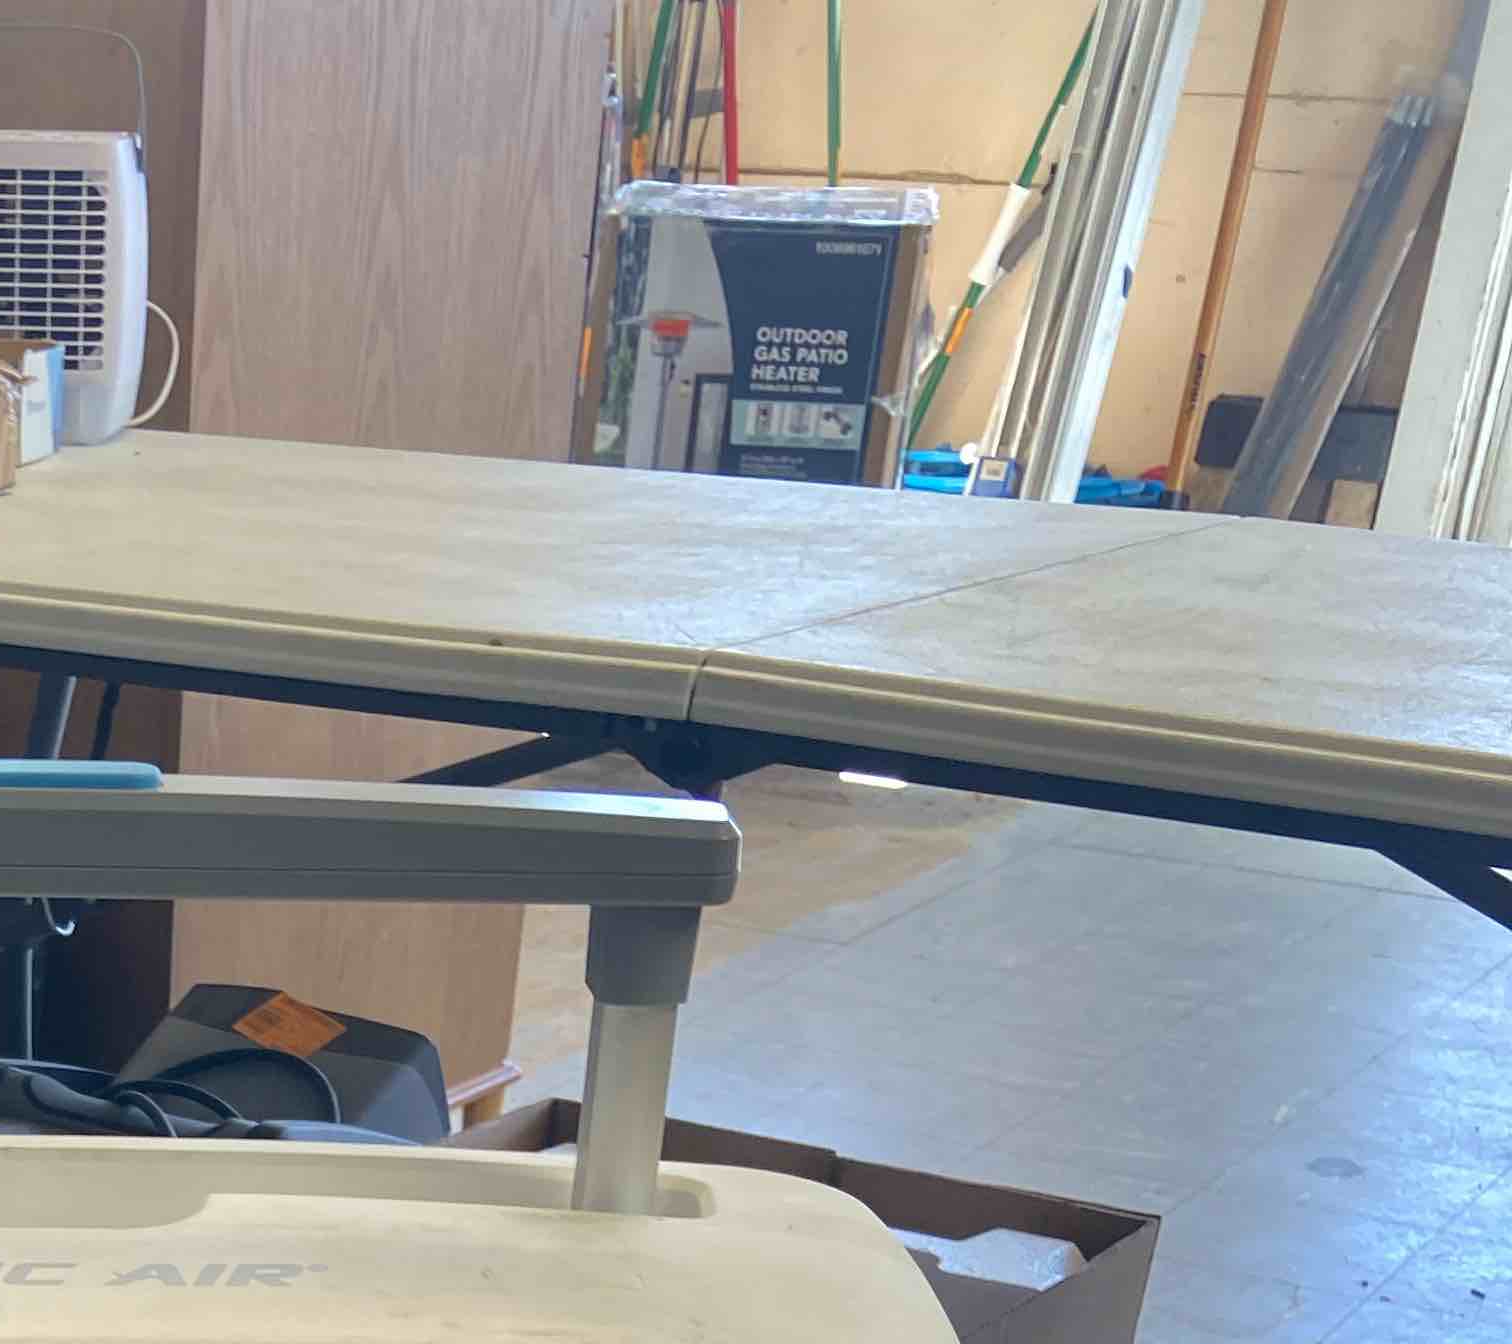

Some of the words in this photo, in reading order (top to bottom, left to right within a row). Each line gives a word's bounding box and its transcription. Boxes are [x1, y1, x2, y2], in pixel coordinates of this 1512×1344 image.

[756, 326, 849, 346] OUTDOOR
[753, 346, 792, 363] GAS
[795, 346, 849, 366] PATIO
[751, 364, 821, 383] HEATER
